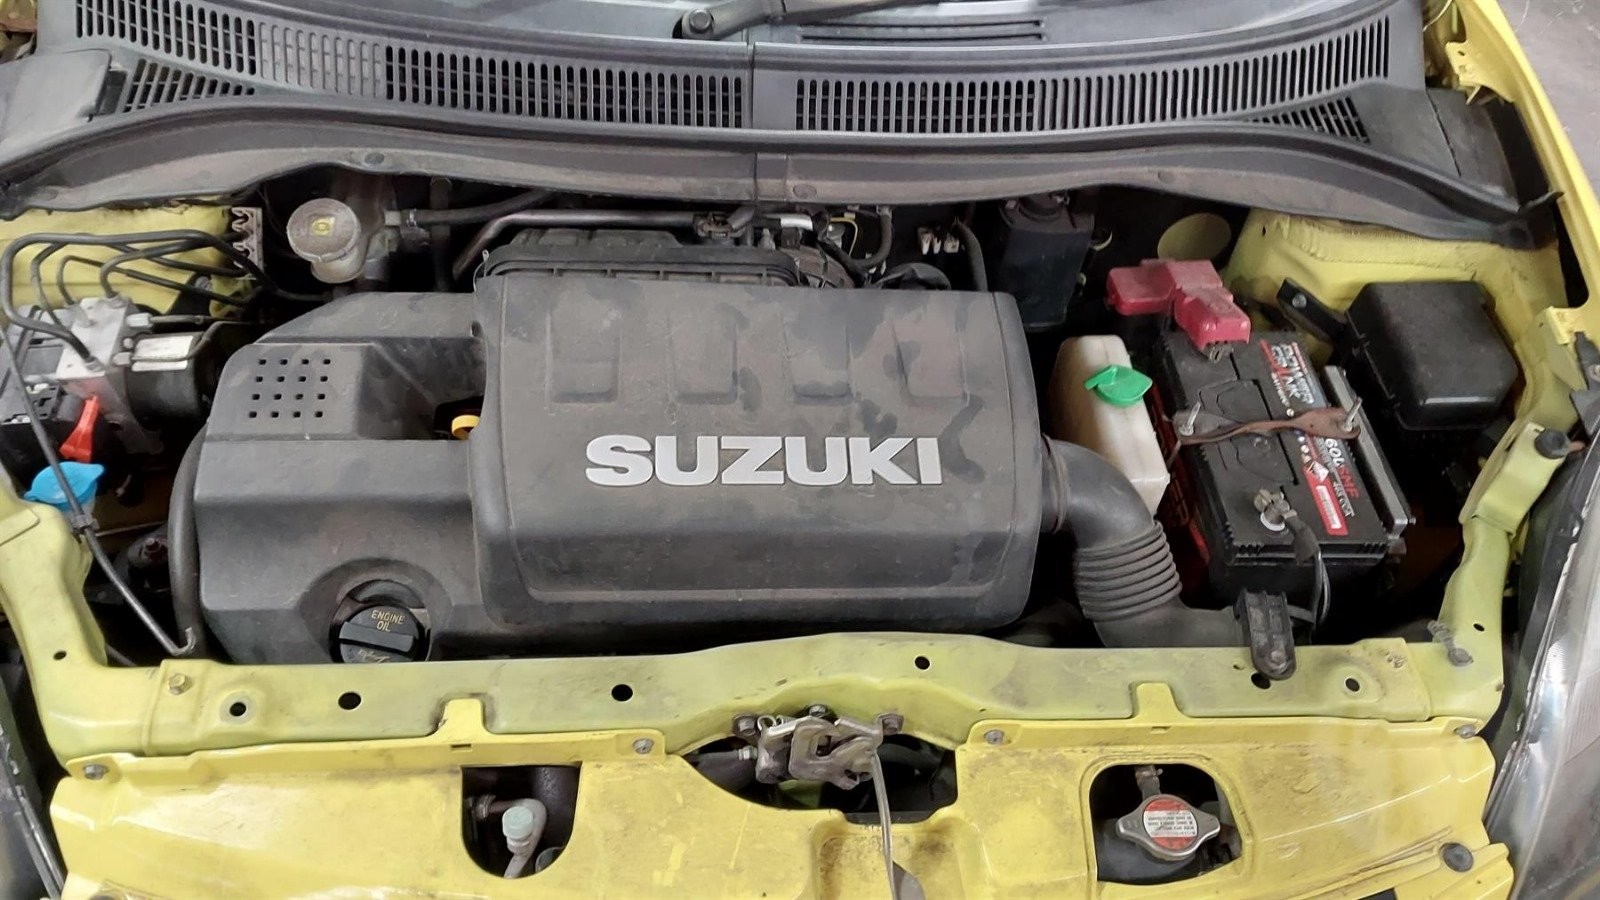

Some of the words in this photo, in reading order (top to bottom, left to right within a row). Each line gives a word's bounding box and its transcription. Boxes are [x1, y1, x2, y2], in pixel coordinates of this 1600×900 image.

[585, 434, 942, 486] SUZUKI
[371, 609, 406, 625] ENGINE
[376, 620, 391, 632] OIL
